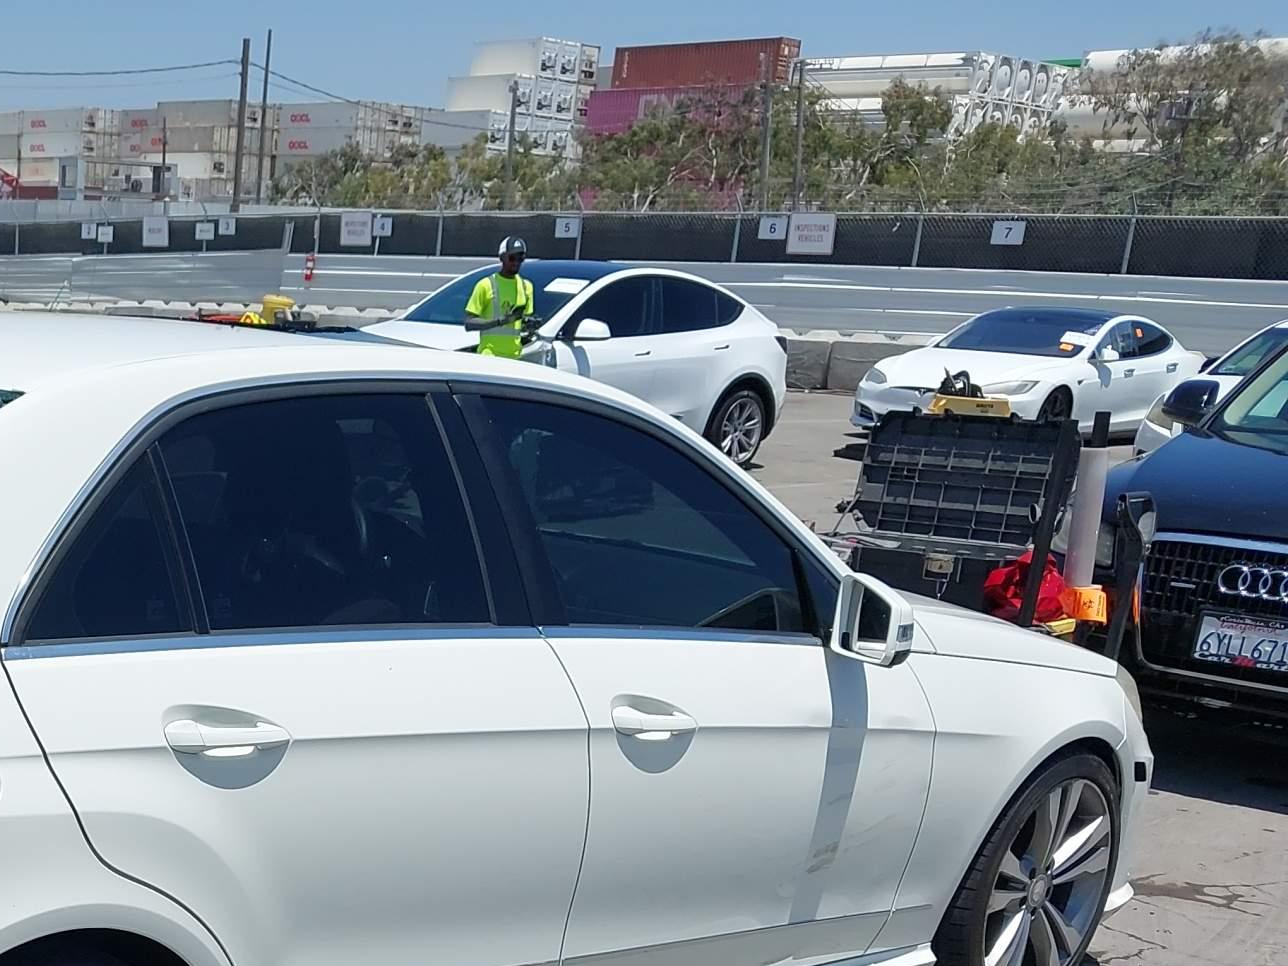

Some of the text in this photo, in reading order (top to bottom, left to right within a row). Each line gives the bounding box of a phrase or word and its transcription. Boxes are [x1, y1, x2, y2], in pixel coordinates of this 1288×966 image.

[564, 222, 571, 232] 5
[769, 223, 777, 234] 6
[1004, 226, 1013, 239] 7
[1199, 631, 1288, 667] 6YLL671
